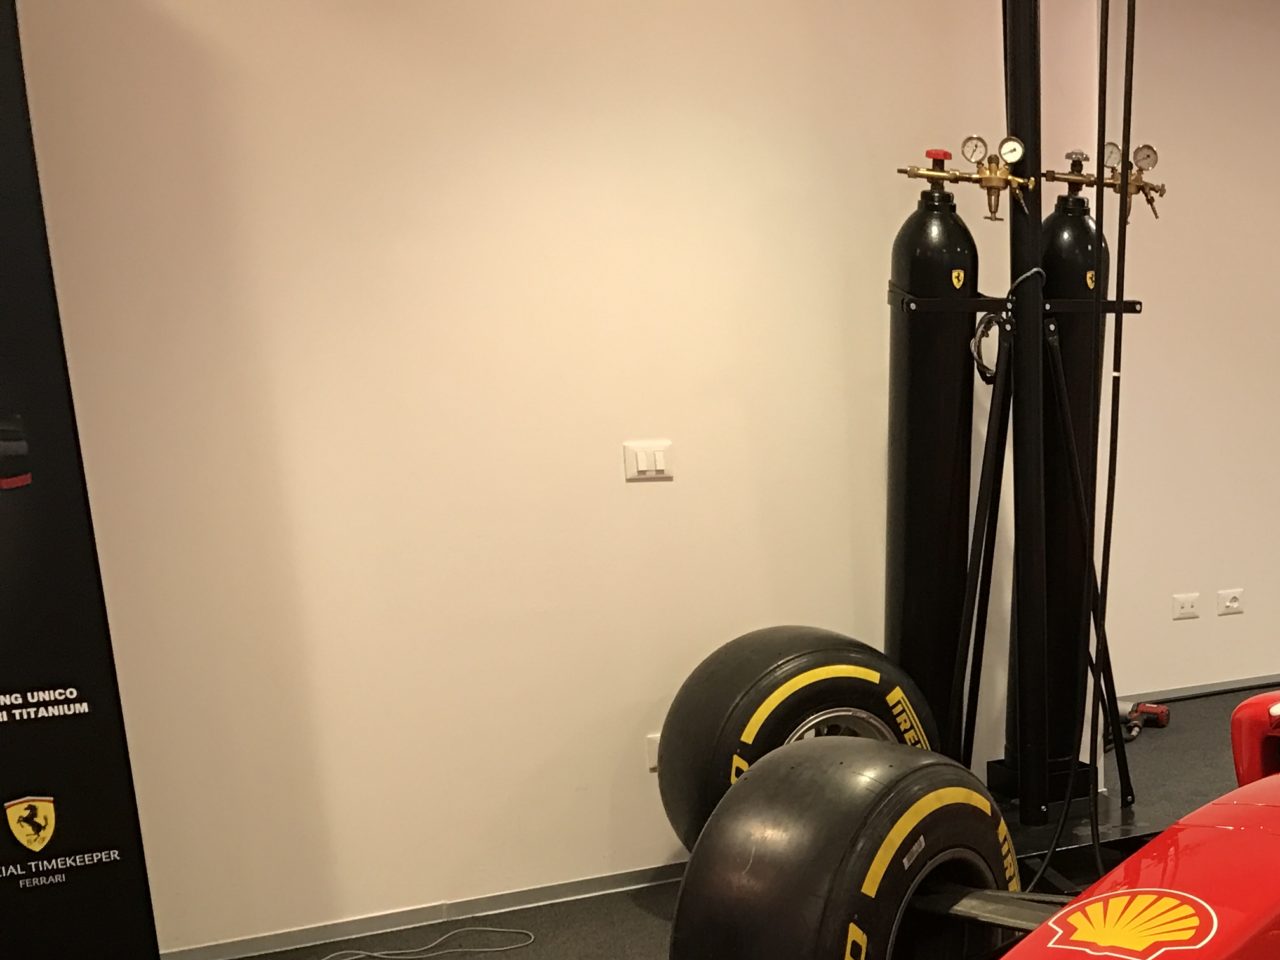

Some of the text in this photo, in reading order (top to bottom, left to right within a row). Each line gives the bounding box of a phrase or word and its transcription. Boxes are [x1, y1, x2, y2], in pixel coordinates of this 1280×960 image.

[26, 688, 78, 703] UNICO
[12, 702, 89, 720] TITANIUM
[0, 849, 121, 878] IAL TIMEKEEPER
[19, 873, 66, 889] FERRARI
